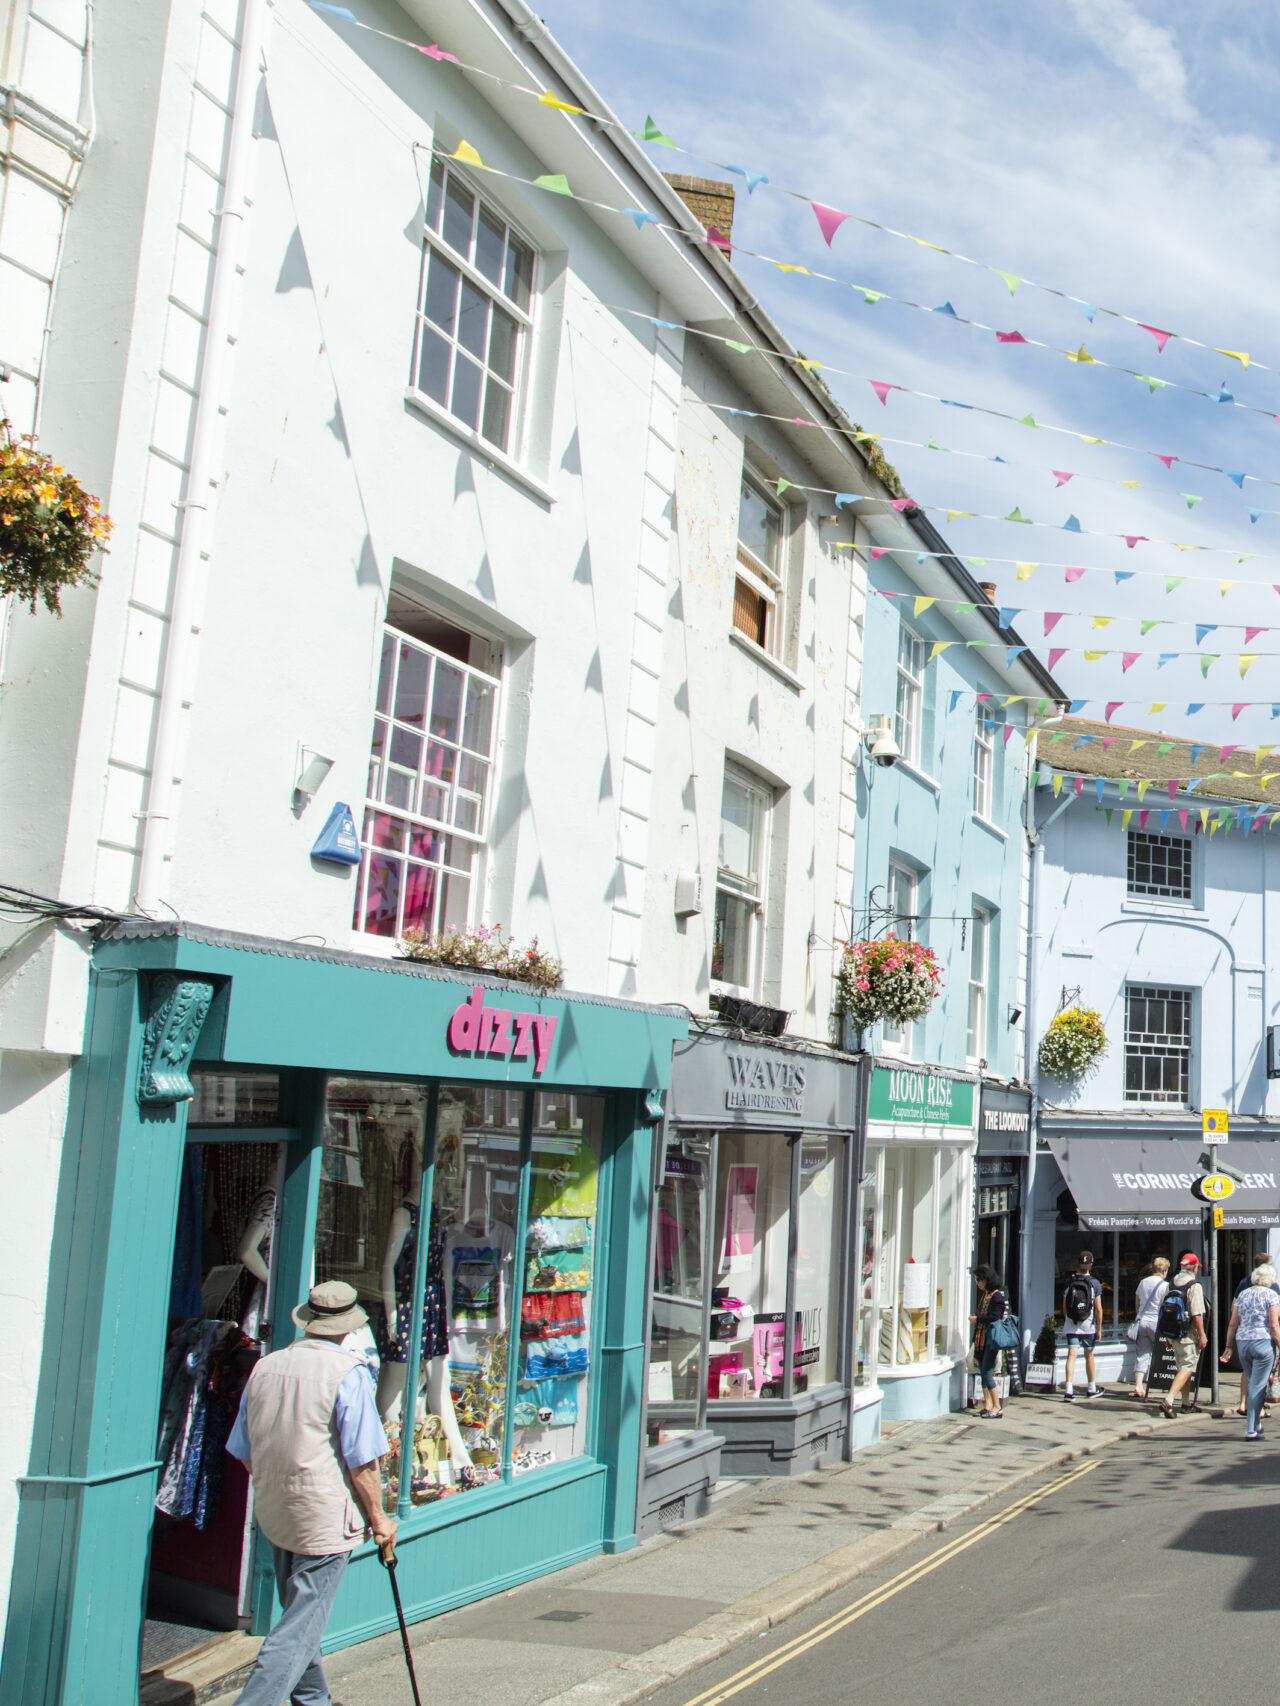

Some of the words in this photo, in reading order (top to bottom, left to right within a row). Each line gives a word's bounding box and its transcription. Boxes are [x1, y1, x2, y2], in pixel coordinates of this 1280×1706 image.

[449, 985, 558, 1072] dizzy
[728, 1055, 806, 1095] WAVES
[888, 1070, 925, 1104] MOON
[927, 1076, 952, 1108] RISE
[730, 1092, 803, 1112] HAIRDRESSING
[891, 1104, 919, 1120] Acupuncture
[923, 1105, 939, 1119] Chinese
[984, 1110, 998, 1131] THE
[998, 1111, 1029, 1132] LOOKOUT
[1112, 1173, 1126, 1188] THE
[1088, 1217, 1109, 1226] Fresh
[1110, 1216, 1139, 1226] Pastries
[1144, 1216, 1166, 1226] Voted
[1166, 1215, 1193, 1225] World's
[1238, 1216, 1257, 1225] Pasty
[1261, 1215, 1280, 1224] Hand
[771, 1313, 784, 1322] ghd
[1028, 1365, 1051, 1375] GARDEN
